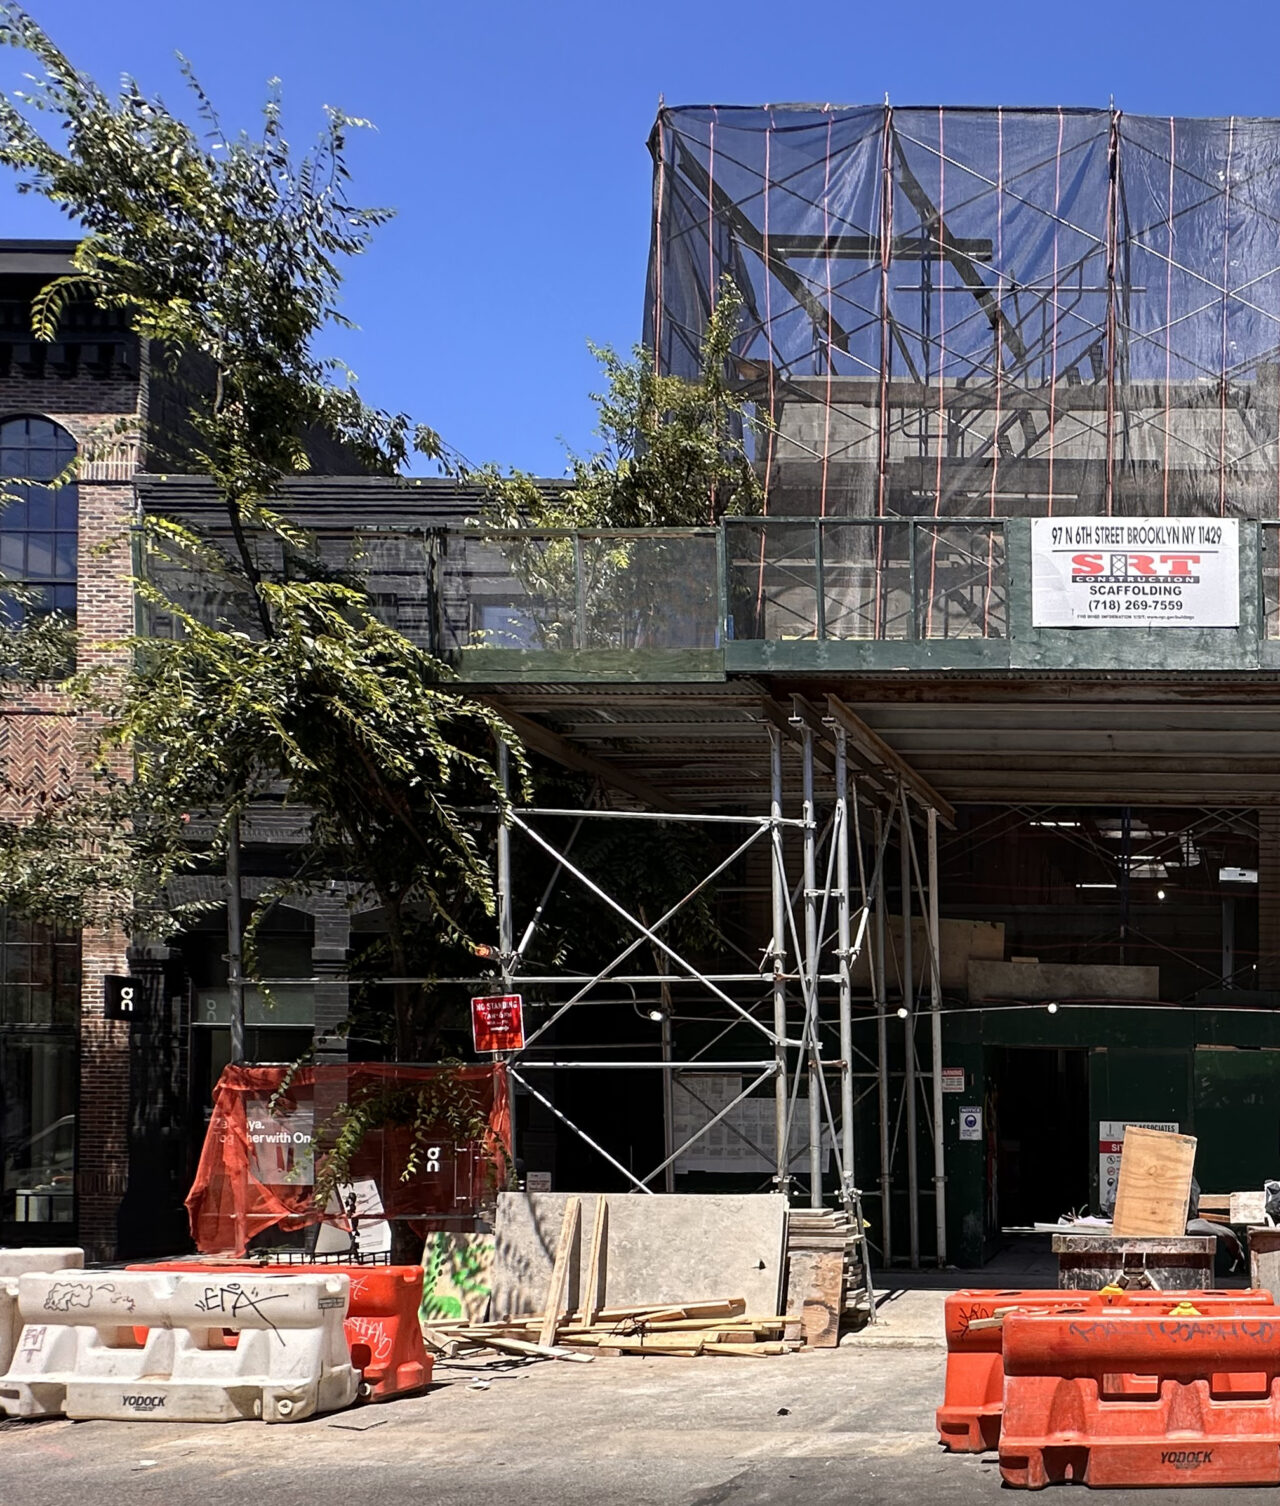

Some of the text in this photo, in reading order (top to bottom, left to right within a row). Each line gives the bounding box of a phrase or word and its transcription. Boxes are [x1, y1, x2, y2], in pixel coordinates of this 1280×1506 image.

[1052, 526, 1222, 544] 97 N 6TH STREET BROOKLYN NY 11429
[1072, 554, 1200, 575] SRT
[1090, 585, 1182, 596] SCAFFOLDING
[1089, 600, 1183, 612] (718) 269-7559
[476, 1000, 518, 1011] NO STANDING
[266, 1132, 291, 1143] with
[293, 1132, 311, 1143] On
[122, 1395, 167, 1407] YODOCK
[1161, 1450, 1214, 1464] YODOCK
